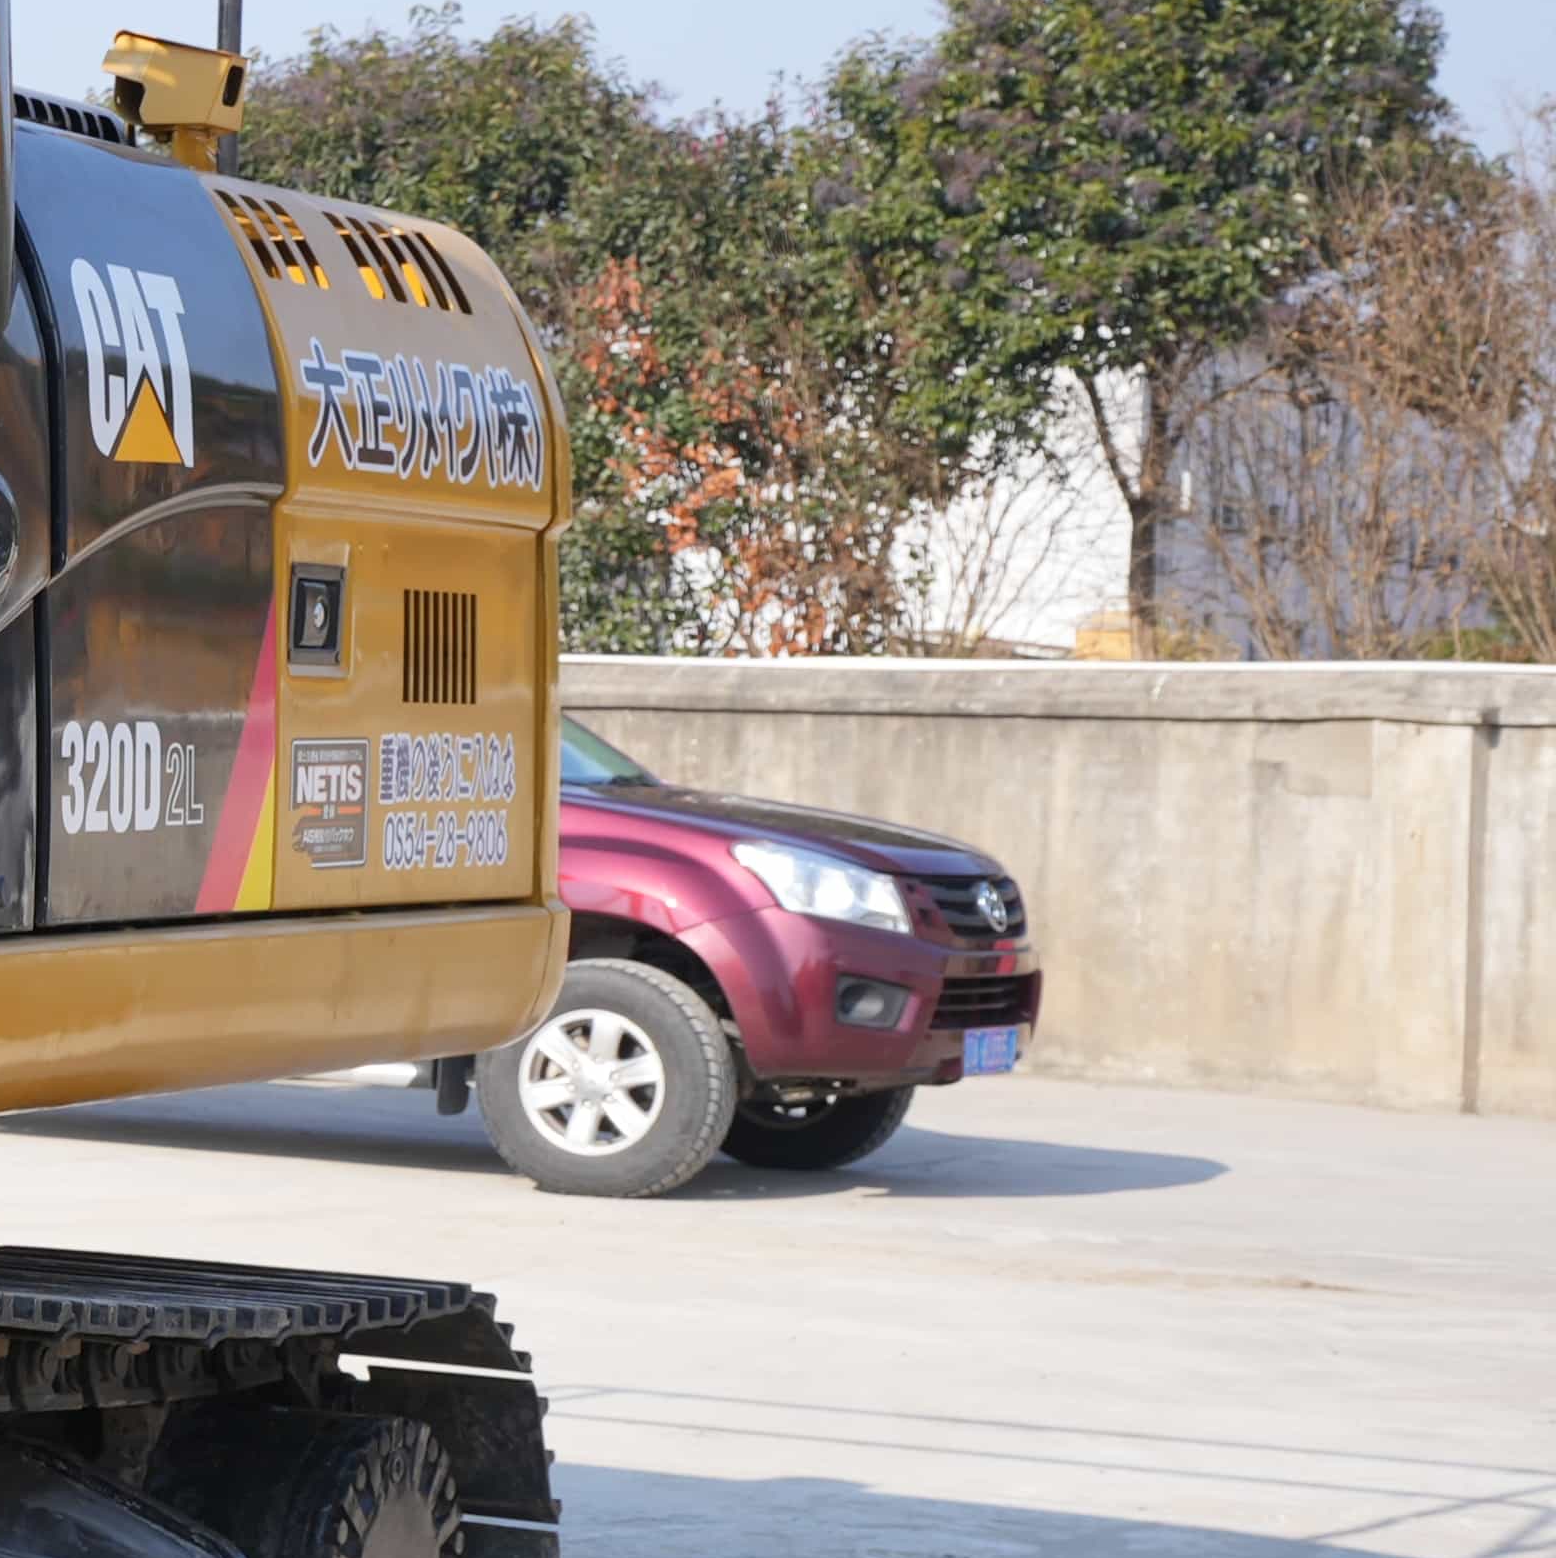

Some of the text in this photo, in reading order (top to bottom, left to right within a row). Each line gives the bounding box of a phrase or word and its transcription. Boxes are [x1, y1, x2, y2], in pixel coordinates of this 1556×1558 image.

[70, 258, 194, 467] CAT
[61, 720, 204, 835] 320D 2L
[296, 764, 363, 804] NETIS
